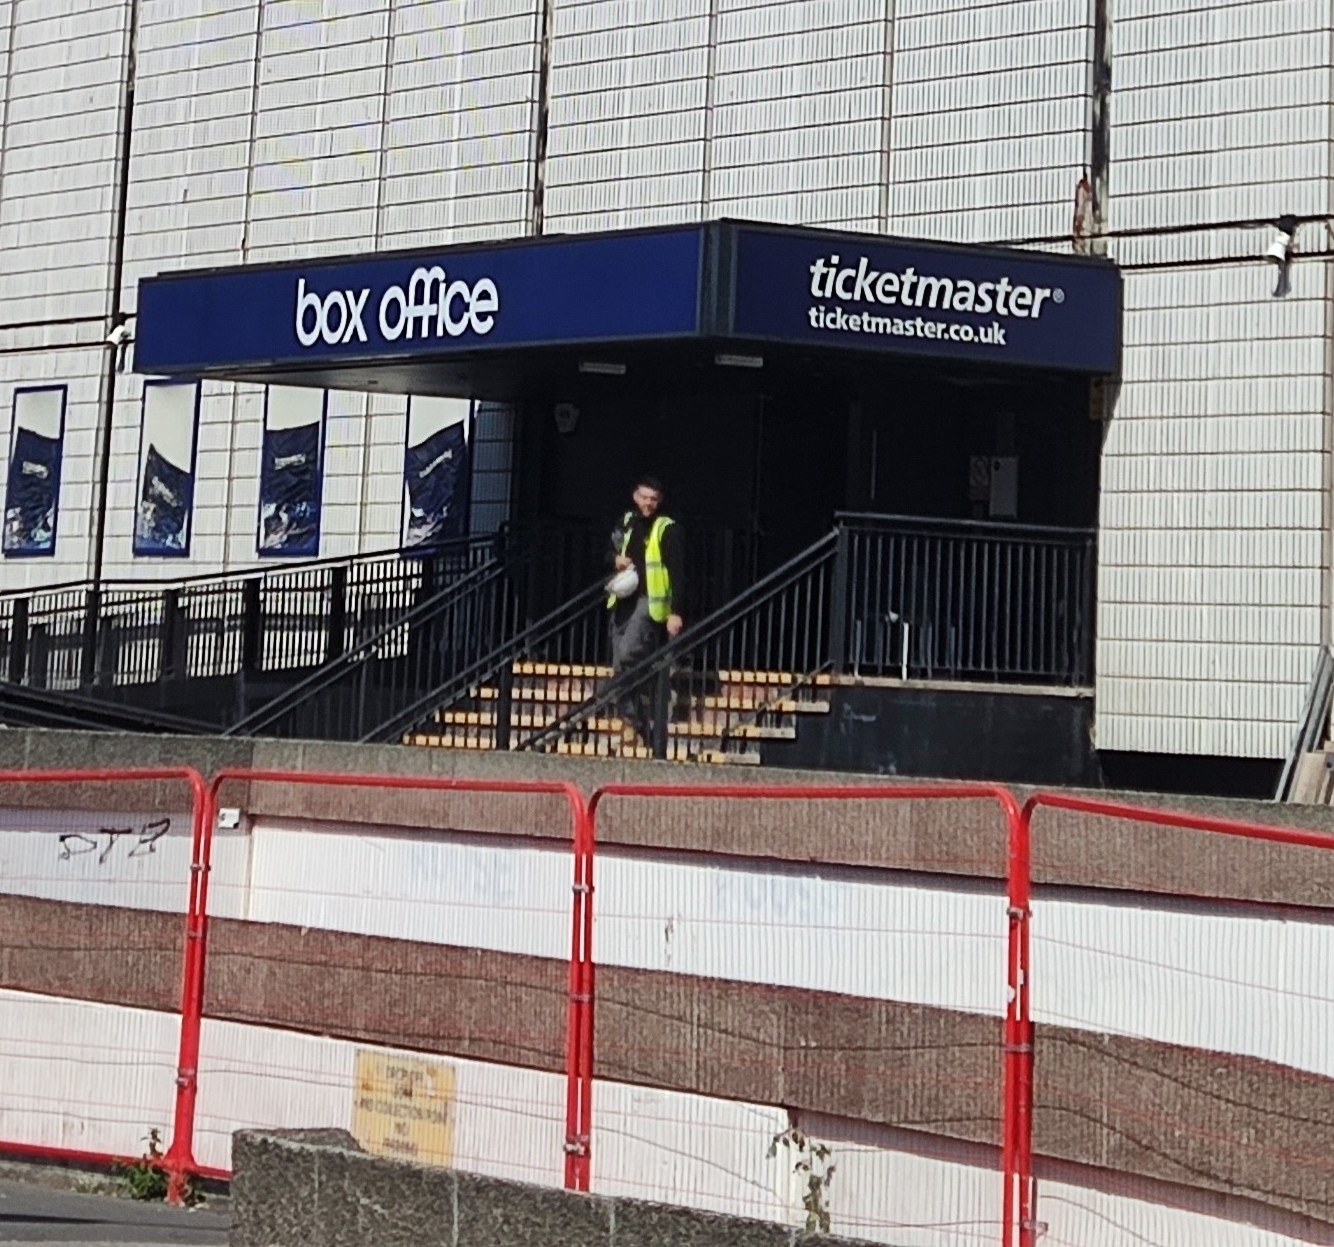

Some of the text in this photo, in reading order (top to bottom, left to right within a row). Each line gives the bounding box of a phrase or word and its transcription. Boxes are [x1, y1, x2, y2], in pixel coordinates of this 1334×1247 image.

[296, 266, 499, 346] box office
[808, 305, 1006, 346] ticketmaster.co.uk
